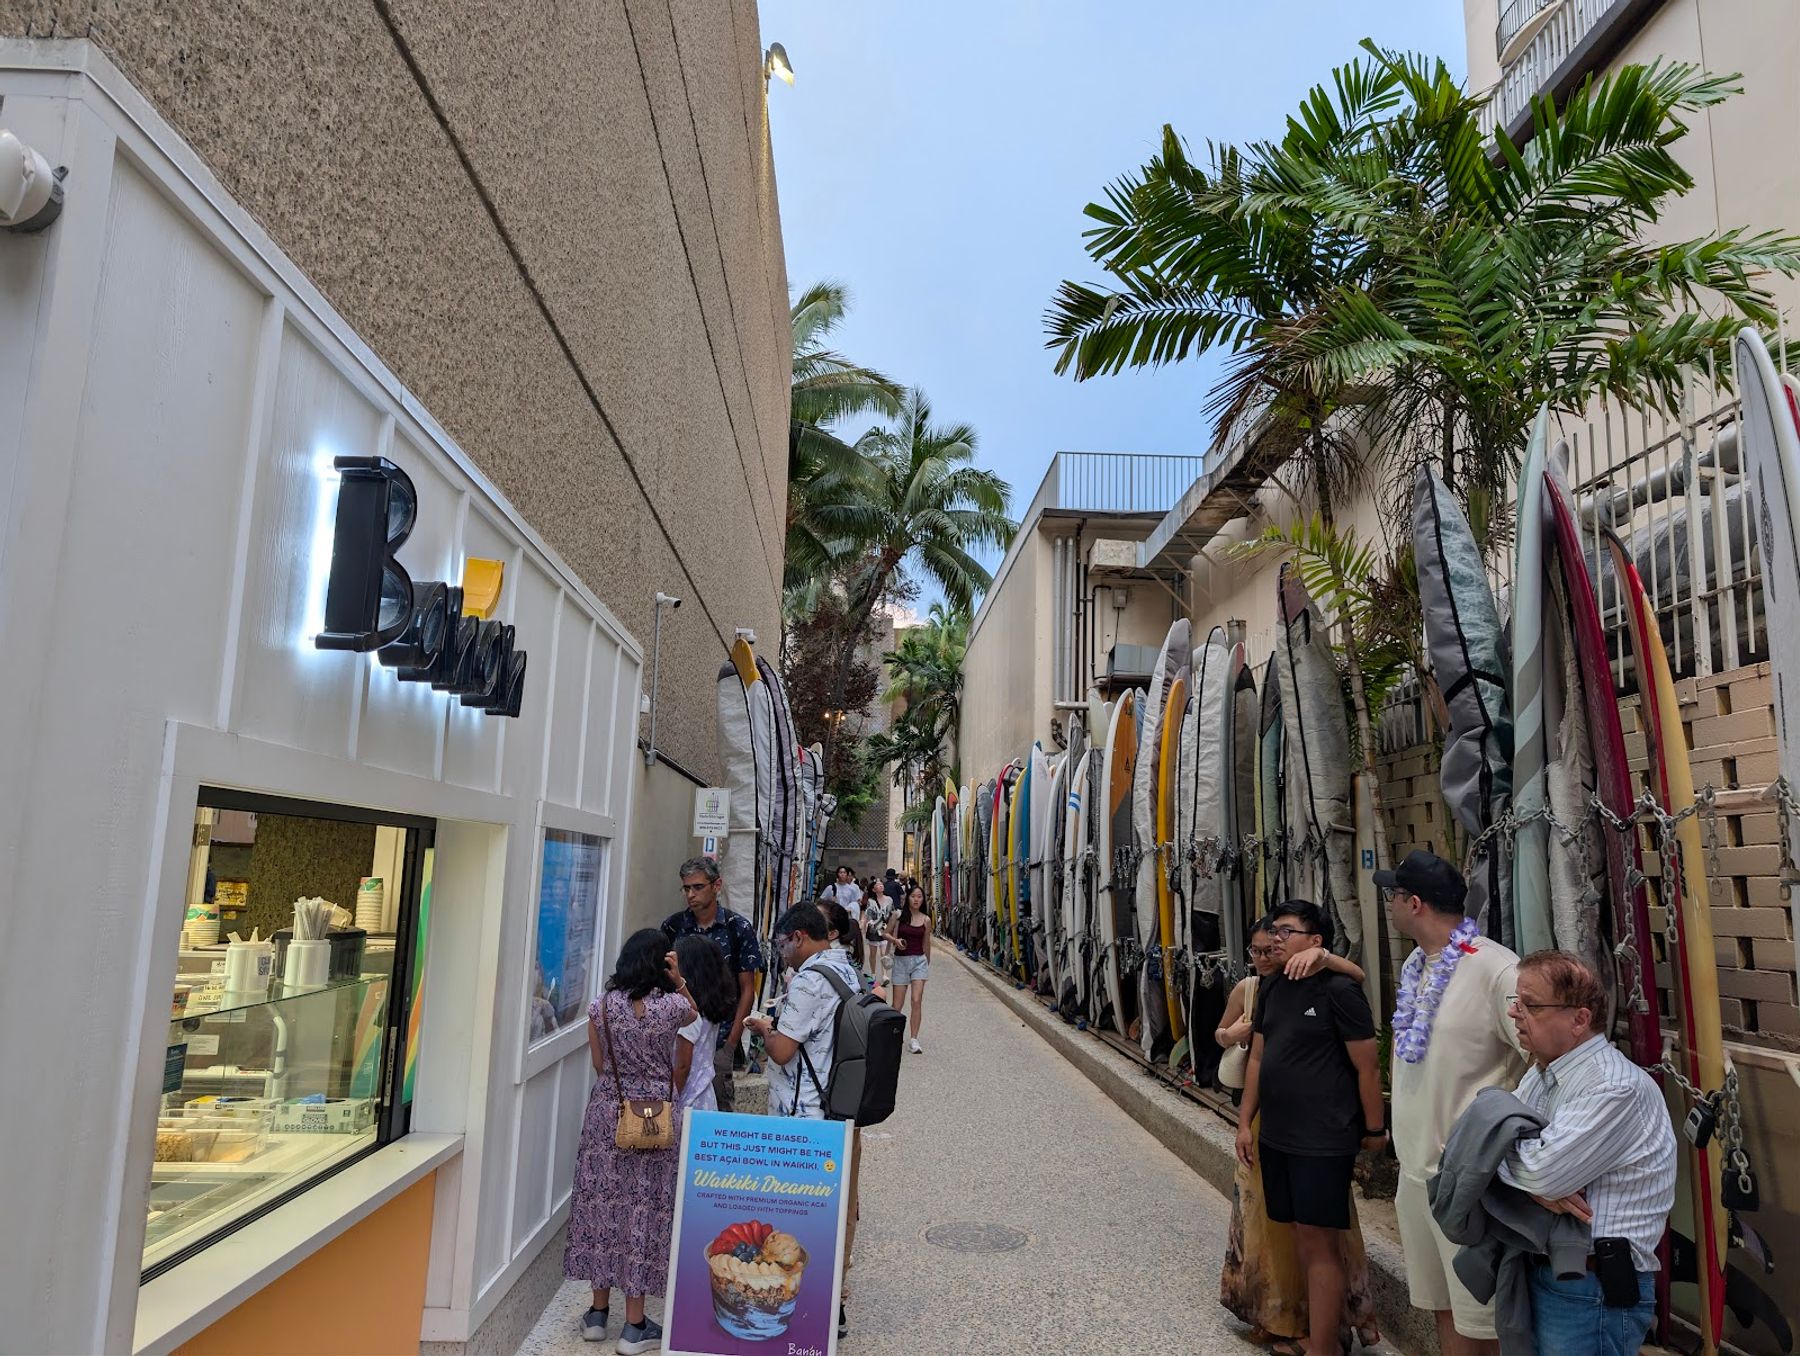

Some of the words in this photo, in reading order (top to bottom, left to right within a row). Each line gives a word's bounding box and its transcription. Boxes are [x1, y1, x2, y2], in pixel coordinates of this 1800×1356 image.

[714, 1129, 728, 1138] WE
[730, 1130, 759, 1140] MIGHT
[761, 1132, 773, 1141] BE
[700, 1140, 719, 1149] BUT
[721, 1142, 741, 1151] THIS
[743, 1144, 766, 1153] JUST
[768, 1146, 798, 1156] MIGHT
[814, 1150, 832, 1158] THE
[694, 1153, 717, 1162] BEST
[742, 1157, 769, 1166] BOWL
[771, 1159, 781, 1167] IN
[693, 1169, 761, 1192] Waikiki
[696, 1191, 727, 1201] CRAFTED
[728, 1194, 744, 1202] WITH
[745, 1195, 778, 1205] PREMIUM
[778, 1198, 809, 1207] ORGANIC
[728, 1203, 753, 1212] LOADED
[775, 1208, 808, 1216] TOPPINGS
